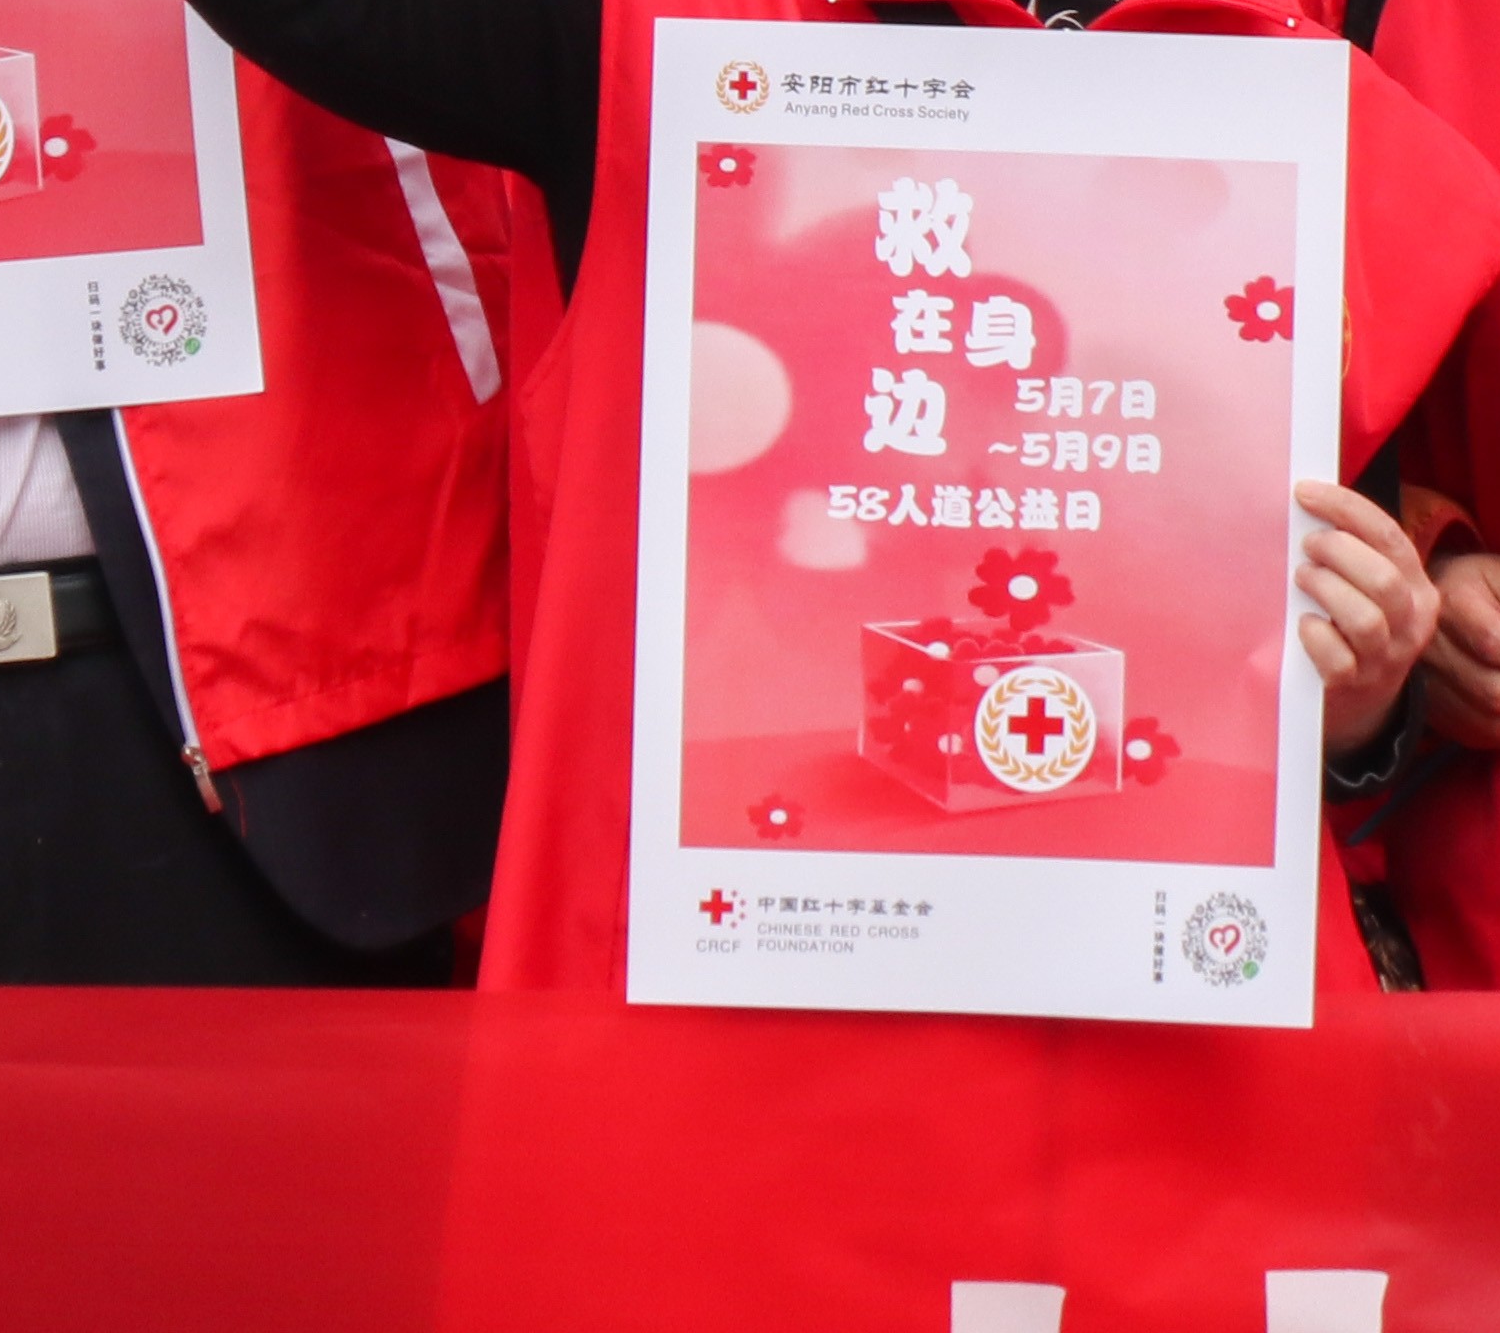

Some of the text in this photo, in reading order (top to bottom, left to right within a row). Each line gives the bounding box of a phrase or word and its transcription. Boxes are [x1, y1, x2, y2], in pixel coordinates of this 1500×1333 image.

[781, 73, 975, 99] 安阳市红十字会
[784, 102, 969, 122] Anyang Red Cross Society
[875, 176, 973, 278] 救
[891, 289, 1036, 370] 在身
[1014, 376, 1156, 420] 5月7日
[863, 367, 946, 456] 边
[827, 484, 1101, 532] 58人道公益日
[758, 897, 933, 916] 中国红十字基金会
[758, 923, 920, 939] CHINESE RED CROSS
[696, 939, 741, 953] CRCF
[757, 940, 854, 953] FOUNDATION
